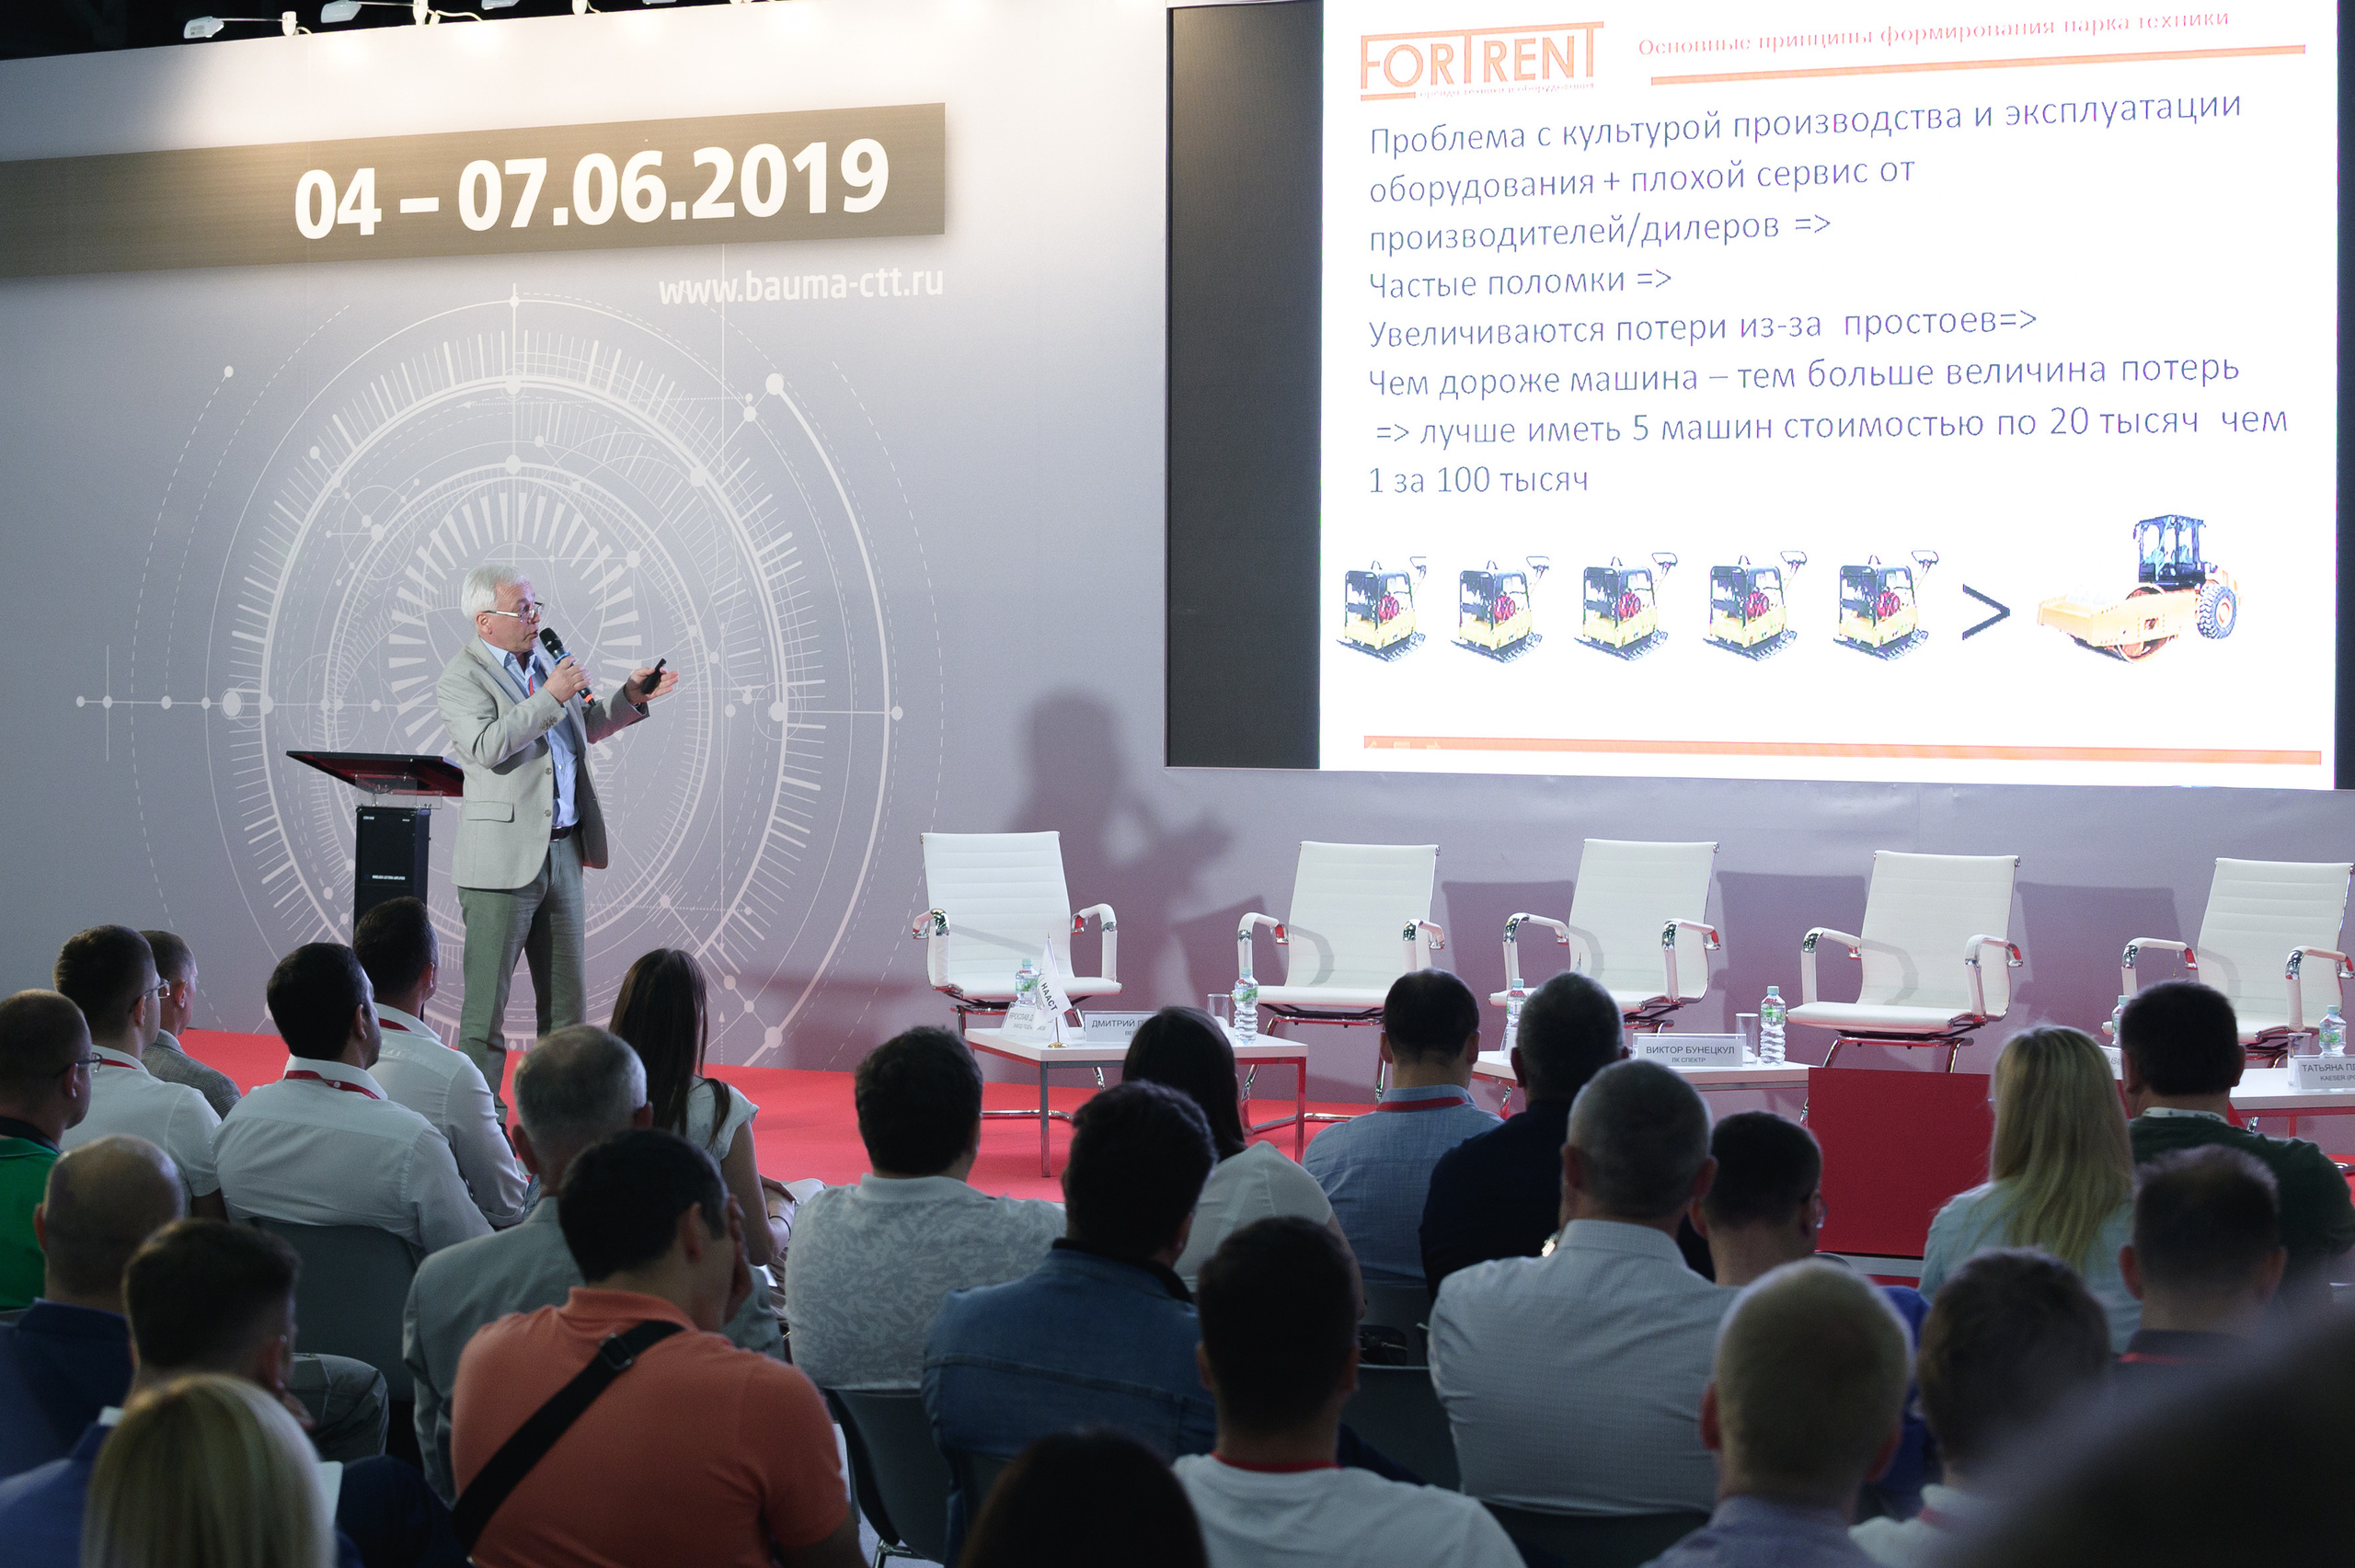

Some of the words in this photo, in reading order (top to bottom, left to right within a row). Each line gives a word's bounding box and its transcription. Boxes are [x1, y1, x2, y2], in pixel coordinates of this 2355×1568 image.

[1638, 40, 1751, 55] Основные
[1760, 31, 1872, 53] принципы
[1881, 21, 2054, 47] формирования
[2064, 16, 2130, 36] парка
[2139, 12, 2229, 29] техники
[1361, 21, 1603, 89] FORTRENT
[1372, 123, 1525, 160] Проблема
[1537, 126, 1551, 147] с
[1563, 110, 1720, 152] культурой
[1734, 108, 1962, 144] производства
[1975, 106, 1993, 128] и
[2005, 95, 2240, 130] эксплуатации
[294, 168, 382, 239] 04
[459, 138, 889, 231] 07.06.2019
[1370, 172, 1594, 208] оборудования
[1603, 172, 1621, 191] +
[1632, 159, 1744, 193] плохой
[1757, 164, 1868, 193] сервис
[1879, 161, 1915, 182] от
[1371, 212, 1779, 258] производителей/дилеров
[1795, 213, 1832, 234] =>
[658, 267, 944, 304] www.bauma-ctt.ru
[1370, 272, 1476, 299] Частые
[1488, 271, 1625, 295] поломки
[1637, 269, 1671, 289] =>
[1368, 321, 1604, 349] Увеличиваются
[1617, 318, 1726, 347] потери
[1740, 316, 1821, 338] из-за
[1844, 309, 2037, 343] простоев=>
[1369, 370, 1429, 396] Чем
[1439, 372, 1560, 401] дороже
[1570, 370, 1697, 393] машина
[1737, 367, 1796, 389] тем
[1808, 358, 1934, 388] больше
[1947, 361, 2106, 385] величина
[2122, 358, 2240, 388] потерь
[1376, 423, 1410, 442] =>
[1419, 423, 1515, 451] лучше
[1529, 421, 1621, 442] иметь
[1633, 414, 1649, 441] 5
[1661, 418, 1772, 441] машин
[1784, 415, 1984, 440] стоимостью
[1998, 415, 2037, 436] по
[2050, 406, 2089, 435] 20
[2099, 411, 2198, 435] тысяч
[2222, 410, 2288, 433] чем
[1370, 467, 1384, 494] 1
[1394, 473, 1424, 494] за
[1438, 465, 1490, 493] 100
[1499, 471, 1588, 493] тысяч
[1040, 982, 1058, 1012] НААСТ
[1091, 1019, 1135, 1028] ДМИТРИЙ
[1646, 1046, 1683, 1054] ВИКТОР
[1685, 1046, 1735, 1056] БУНЕЦКУЛ
[2302, 1063, 2344, 1072] ТАТЬЯНА
